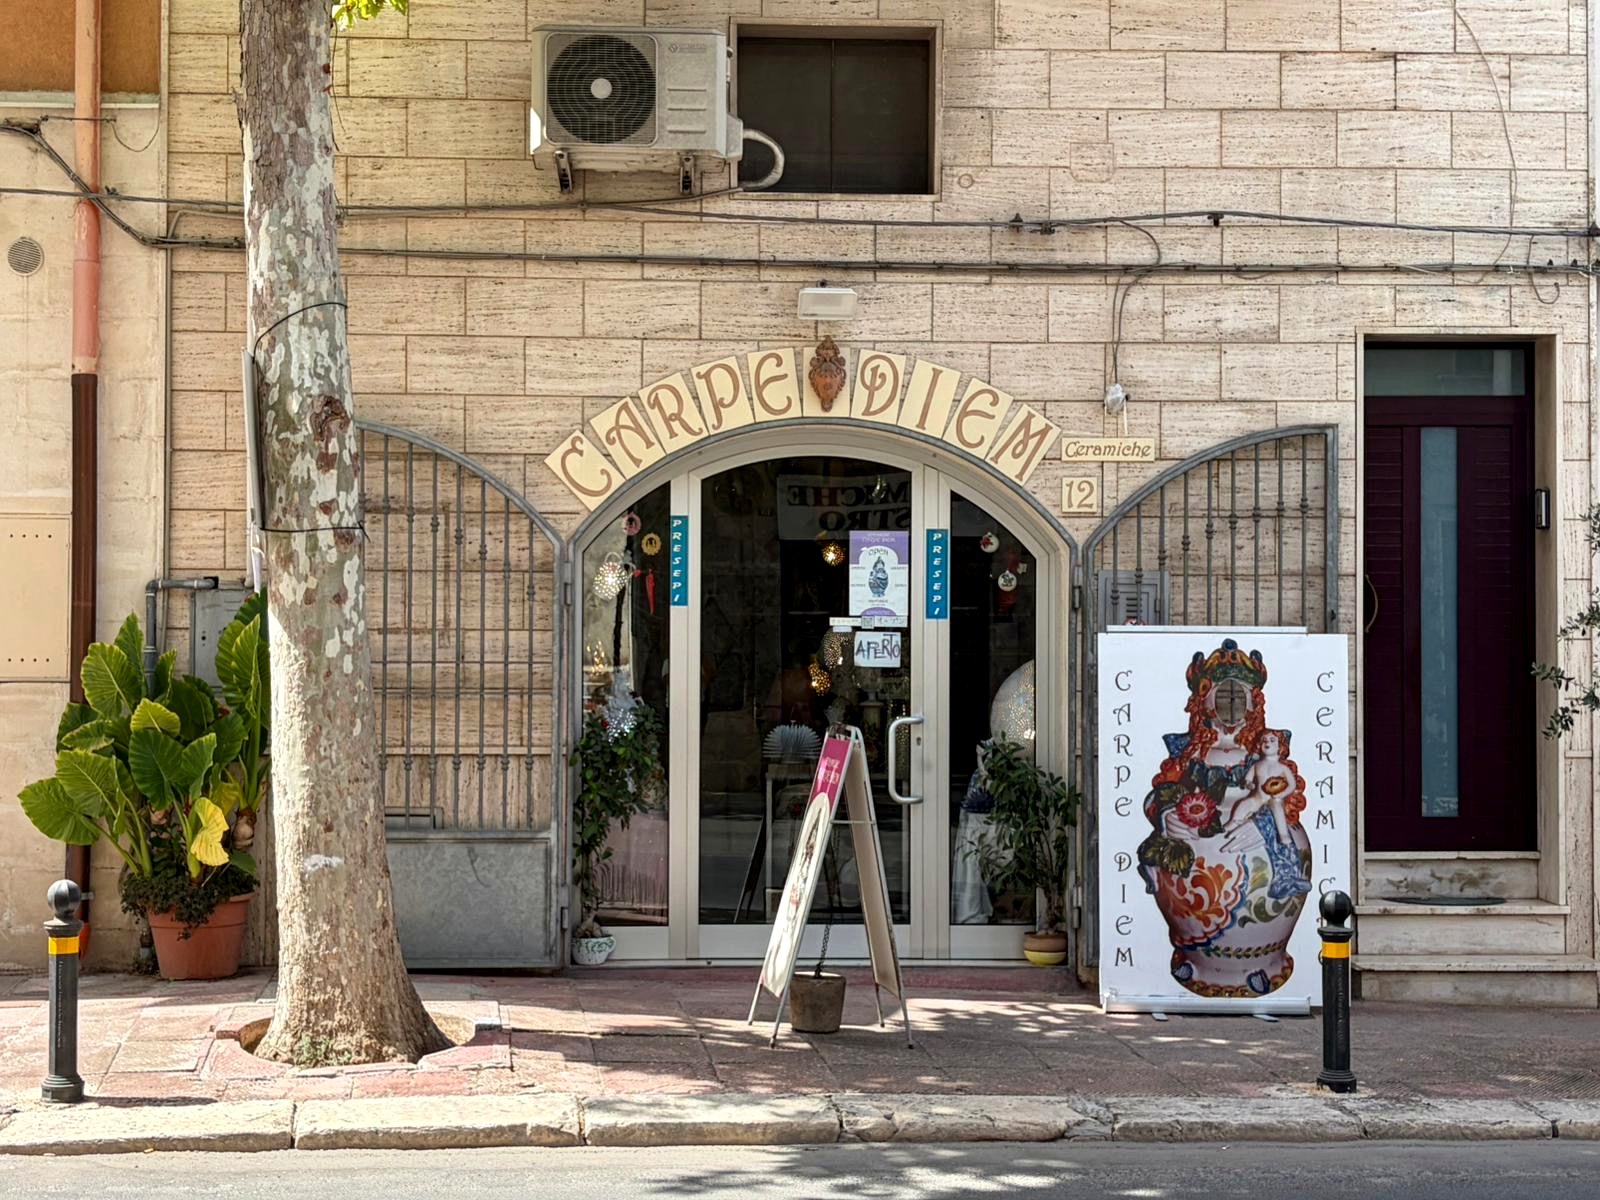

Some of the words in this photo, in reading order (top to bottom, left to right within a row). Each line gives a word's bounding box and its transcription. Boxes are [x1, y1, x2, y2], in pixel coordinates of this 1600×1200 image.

[560, 351, 793, 497] CARPE
[859, 353, 1055, 481] DIEM
[1064, 440, 1154, 459] Ceramiche
[1065, 479, 1095, 509] 12
[672, 519, 682, 602] PRESEPI
[933, 533, 943, 616] PRESEPI
[855, 633, 902, 661] APERTO
[1112, 669, 1133, 818] CARPE
[1113, 852, 1134, 968] DIEM
